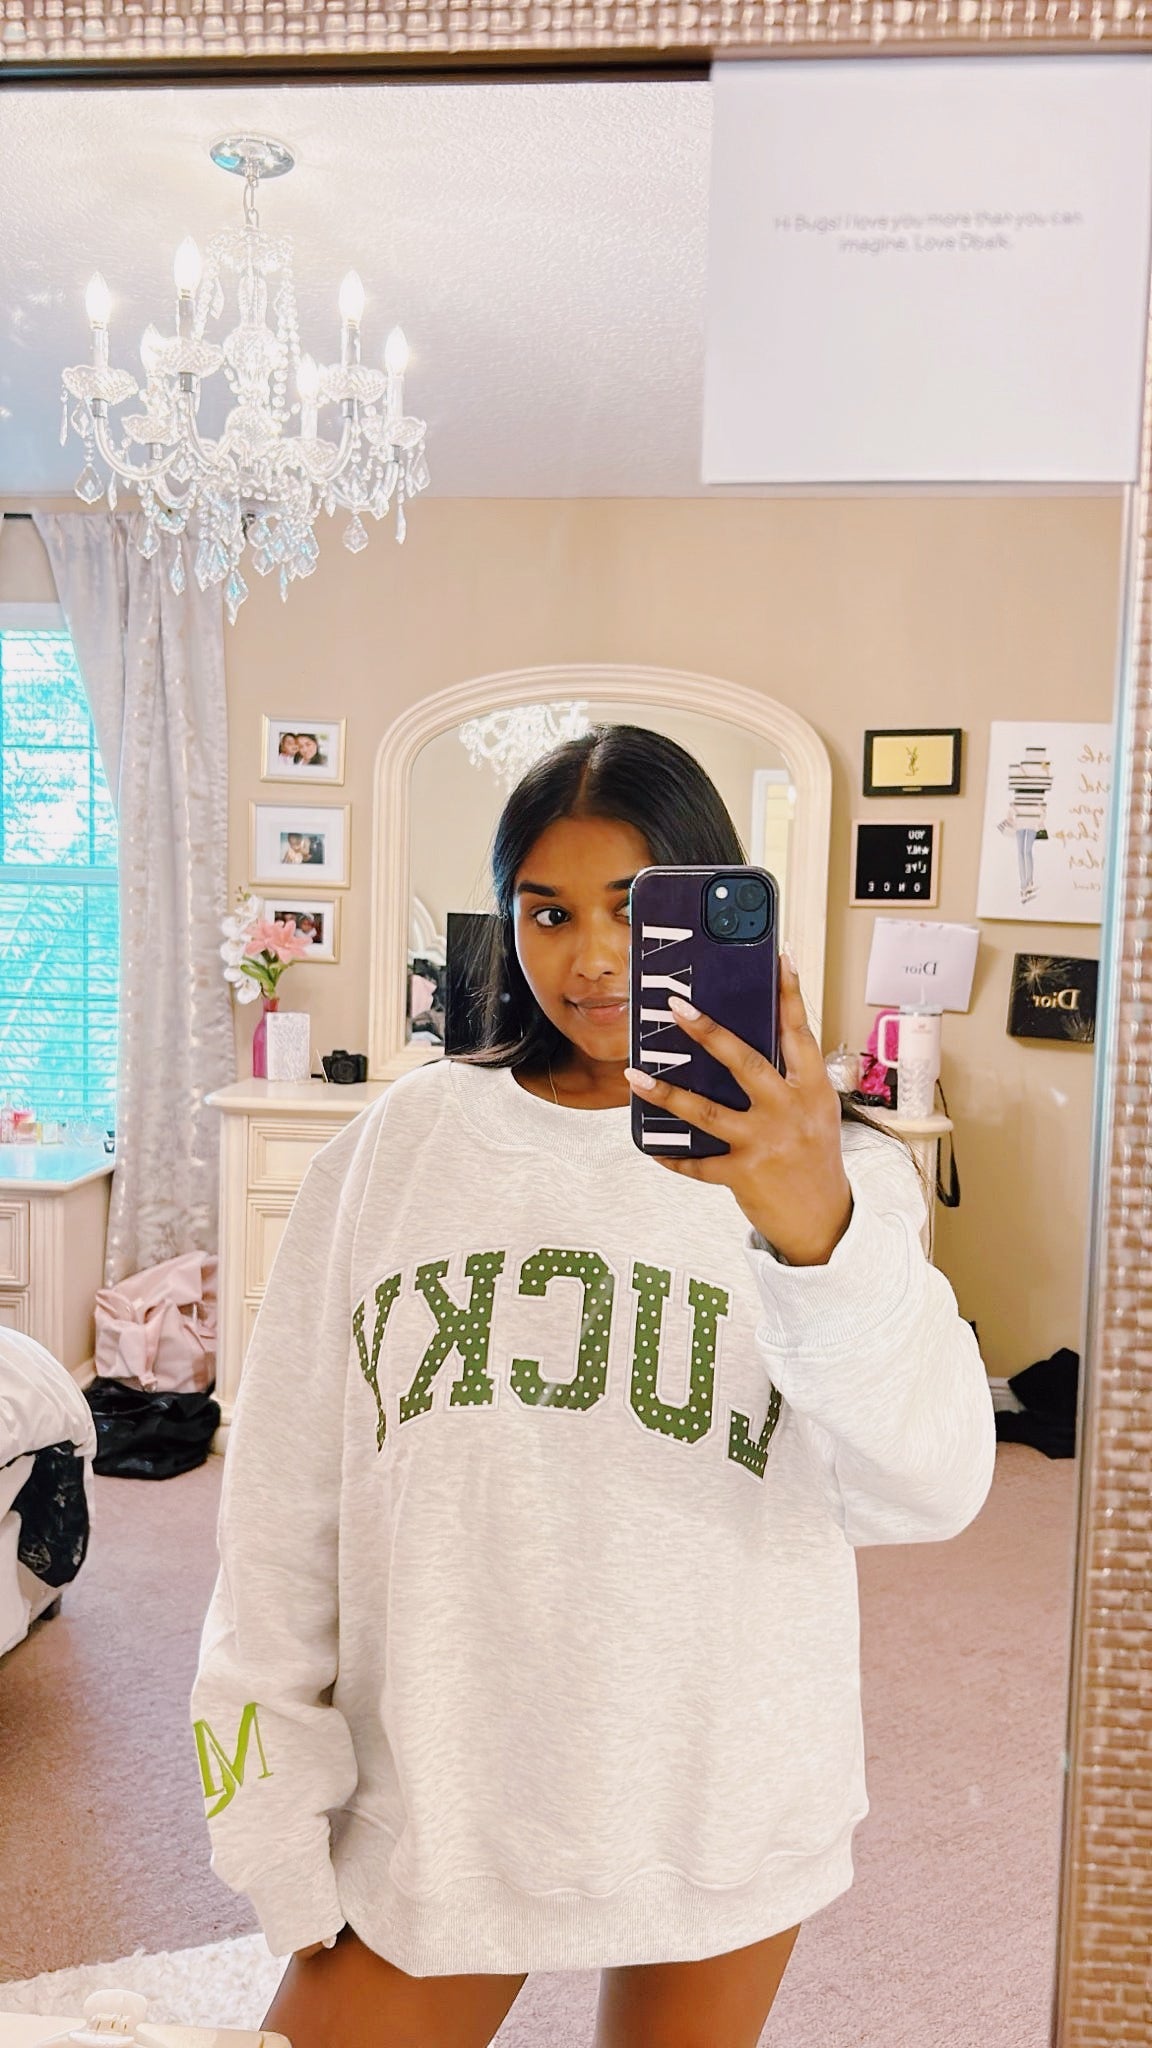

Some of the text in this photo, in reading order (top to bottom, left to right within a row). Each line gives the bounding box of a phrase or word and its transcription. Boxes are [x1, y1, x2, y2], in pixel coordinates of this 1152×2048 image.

[775, 215, 791, 231] Hi
[853, 213, 888, 230] love
[891, 216, 922, 234] you
[928, 214, 970, 229] more
[977, 211, 1014, 227] than
[1016, 213, 1046, 232] you
[1051, 211, 1085, 226] can
